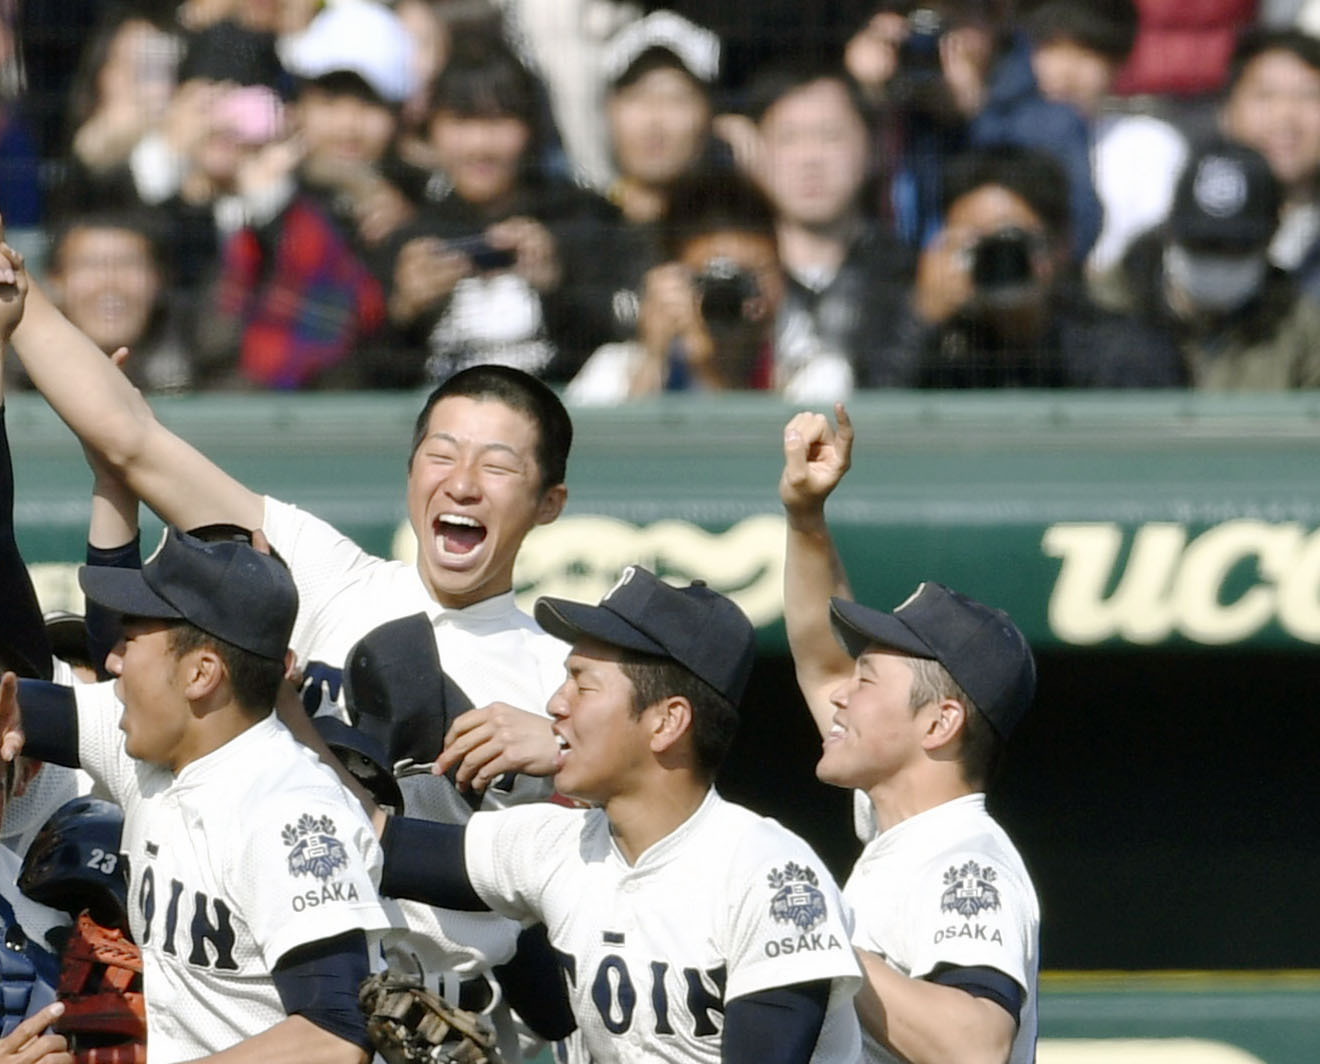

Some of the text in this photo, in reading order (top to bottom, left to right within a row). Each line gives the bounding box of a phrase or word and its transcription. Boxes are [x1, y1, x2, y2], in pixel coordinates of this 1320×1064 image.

[86, 848, 118, 875] 23
[291, 881, 360, 913] OSAKA
[764, 932, 843, 959] OSAKA
[933, 922, 1004, 947] OSAKA
